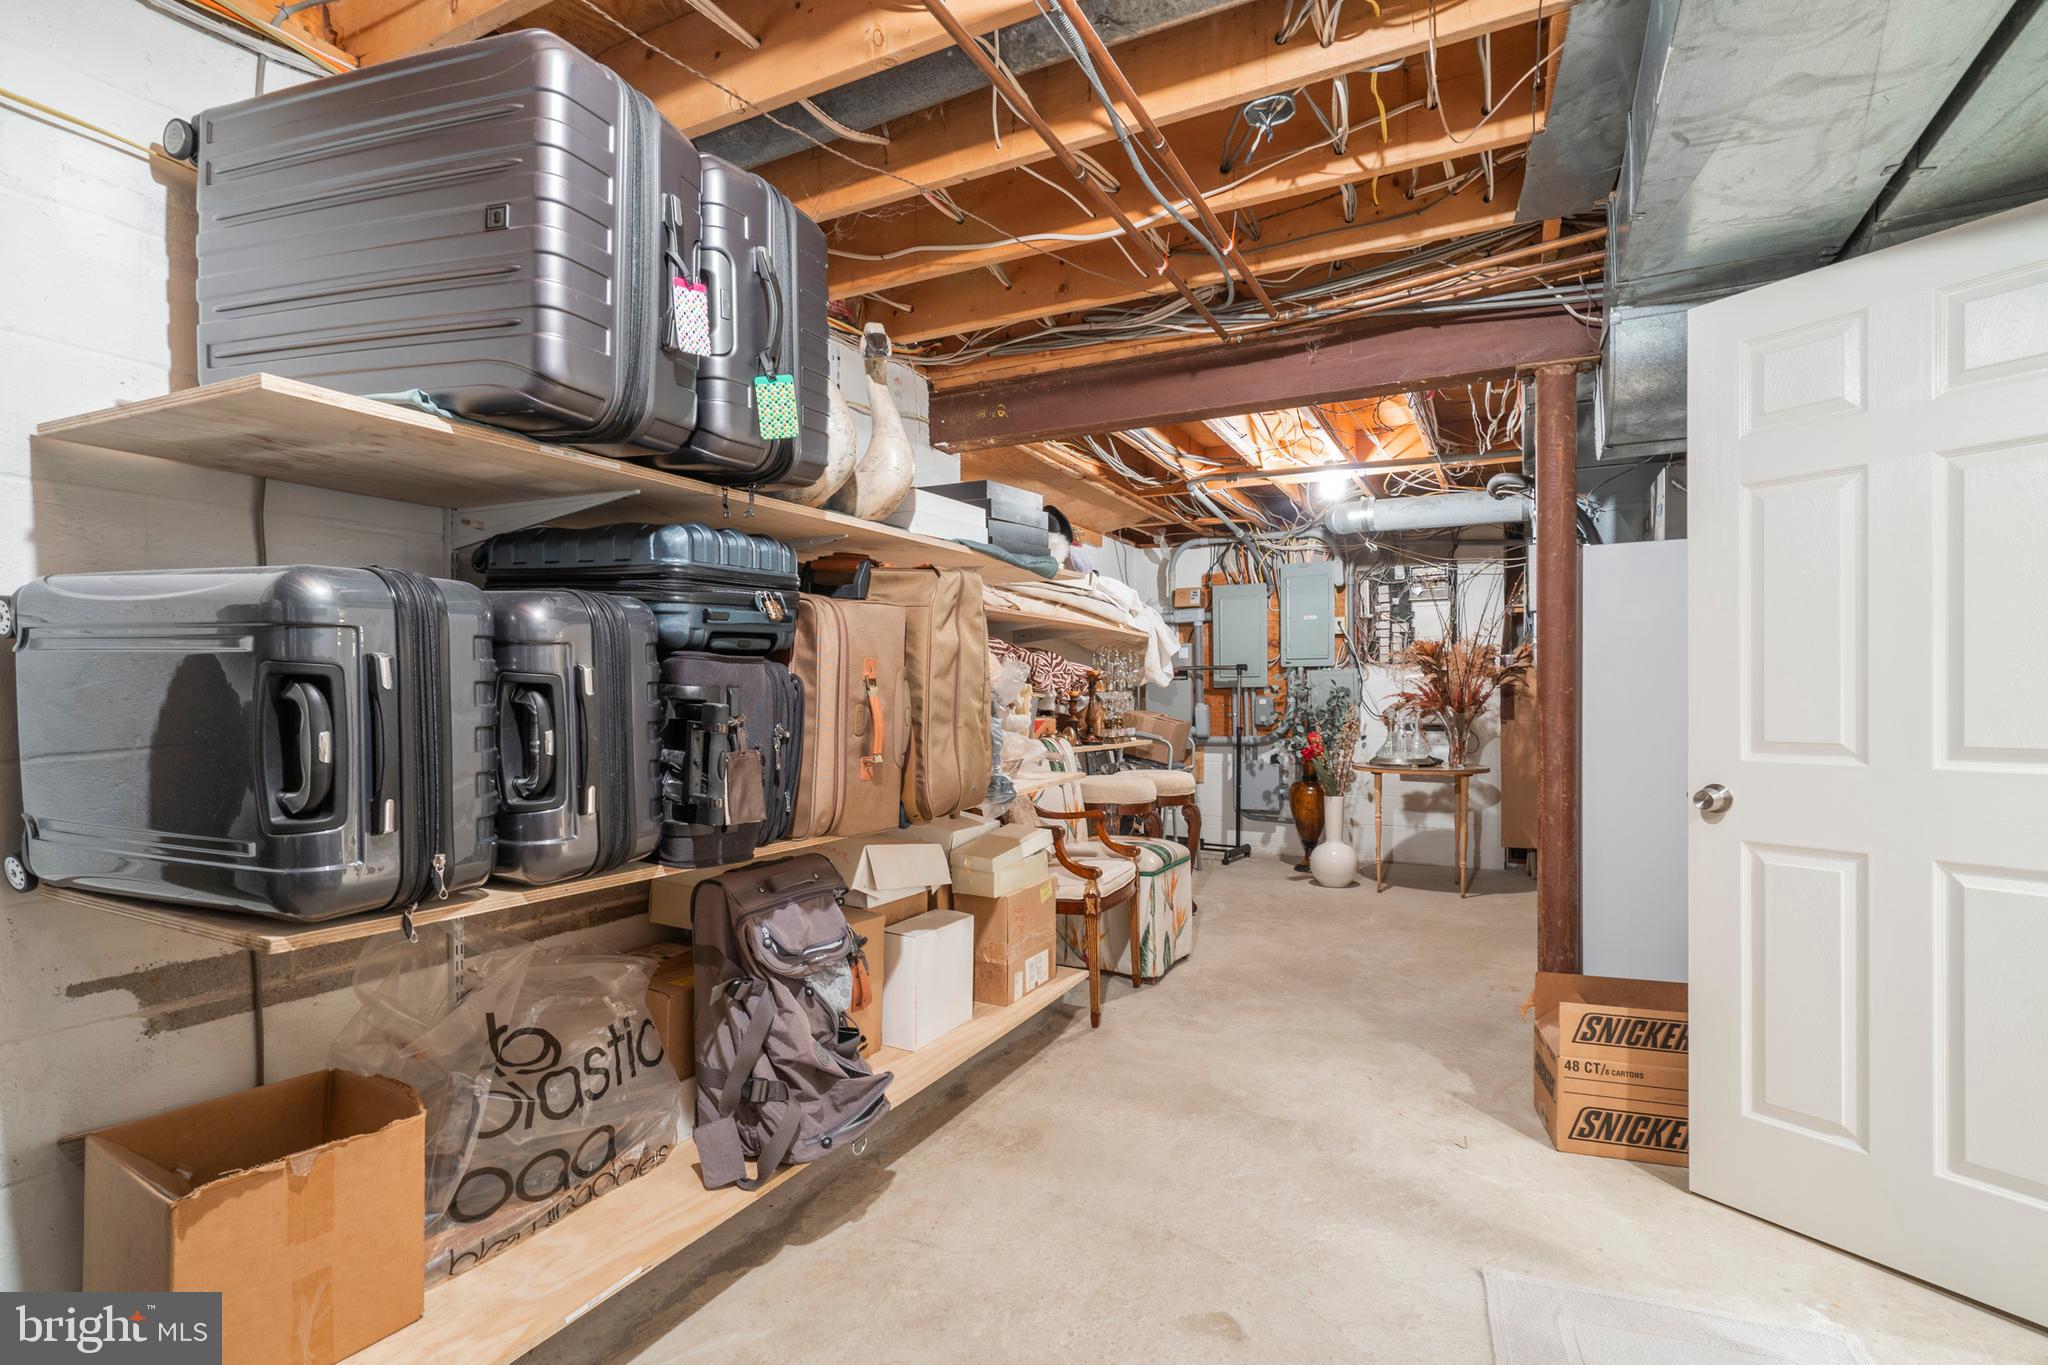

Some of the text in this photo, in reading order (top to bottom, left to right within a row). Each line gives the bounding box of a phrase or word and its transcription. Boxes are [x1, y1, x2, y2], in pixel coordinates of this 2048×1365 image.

[1564, 1060, 1580, 1072] 48
[1611, 1069, 1644, 1080] CARTONS
[1577, 1110, 1688, 1150] SNICKE
